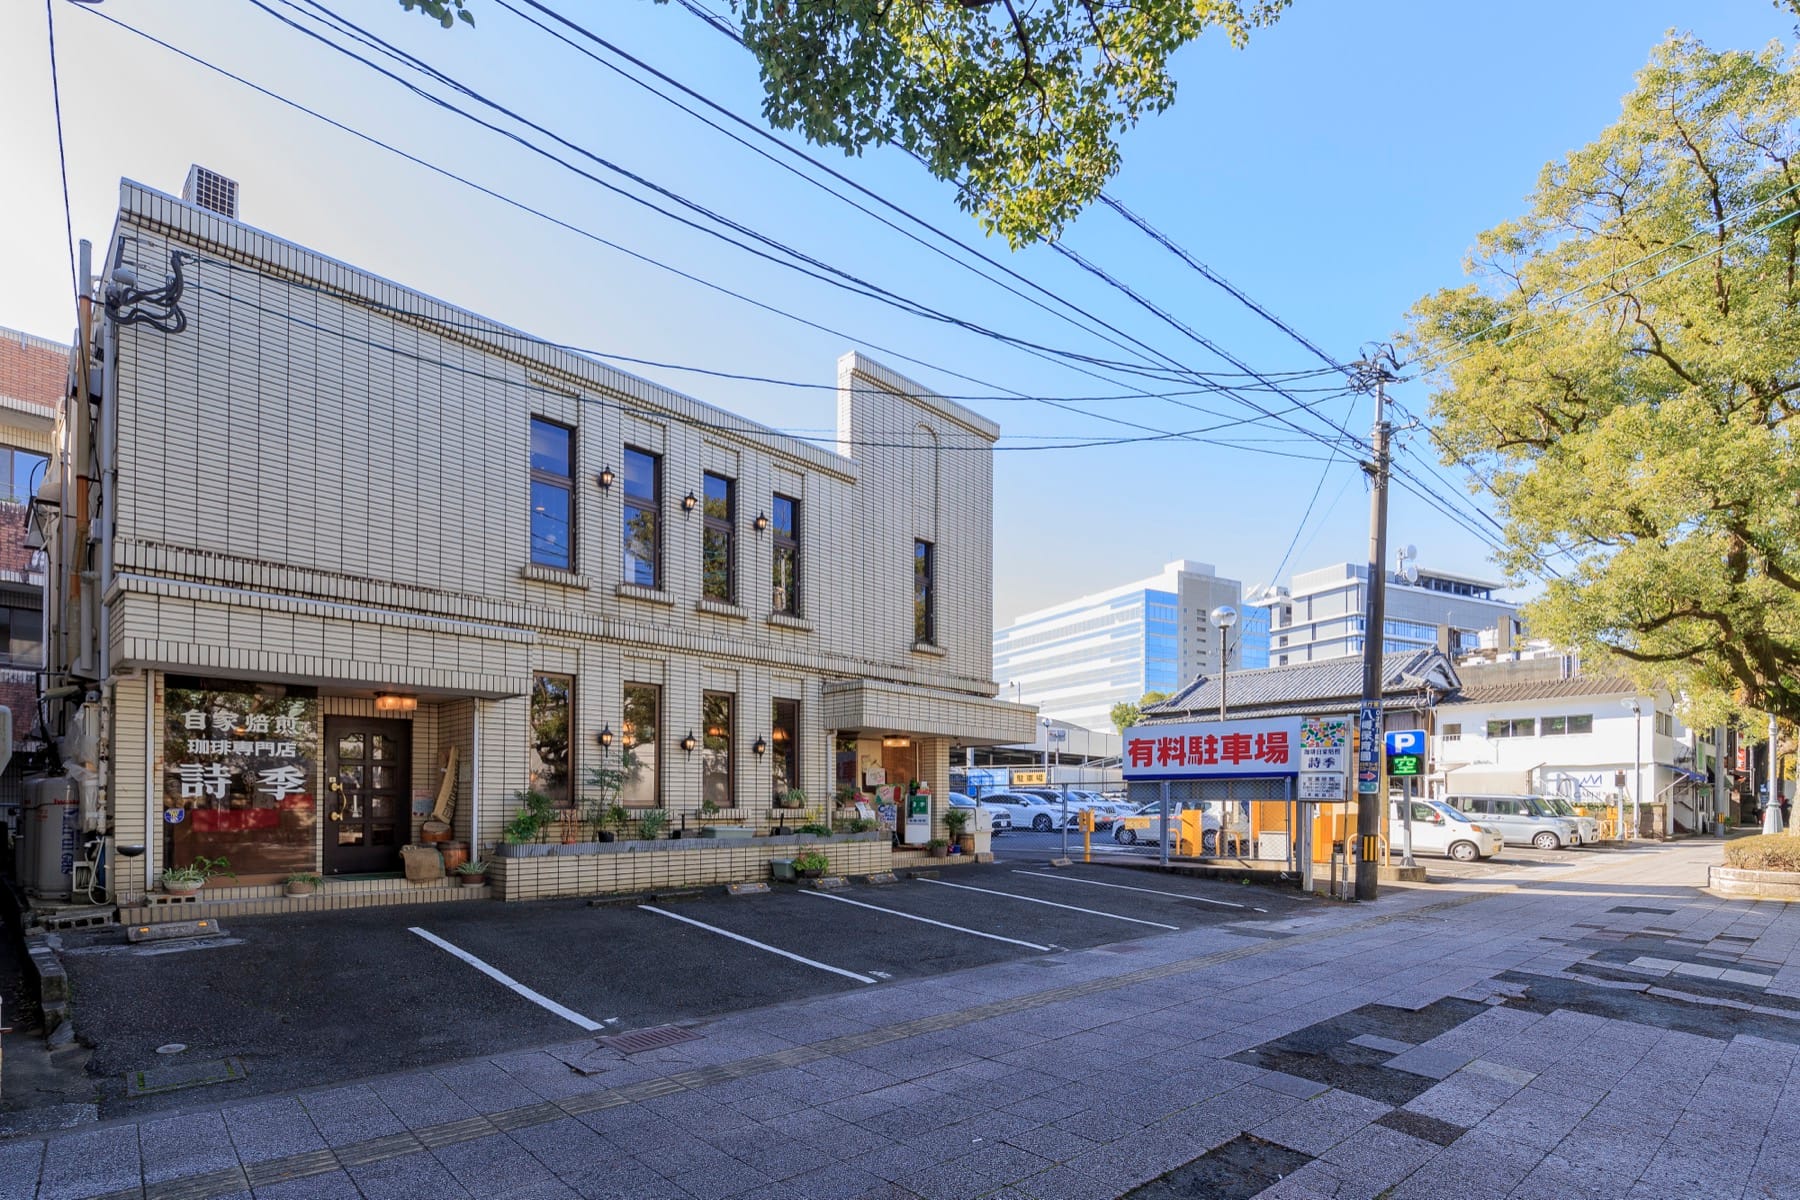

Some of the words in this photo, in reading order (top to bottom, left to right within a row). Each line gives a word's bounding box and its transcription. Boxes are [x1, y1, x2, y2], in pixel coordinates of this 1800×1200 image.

[182, 709, 301, 735] 自家焙煎
[1128, 731, 1289, 768] 有料駐車場
[1394, 733, 1416, 753] P
[1394, 756, 1416, 774] 空
[180, 763, 306, 801] 詩季
